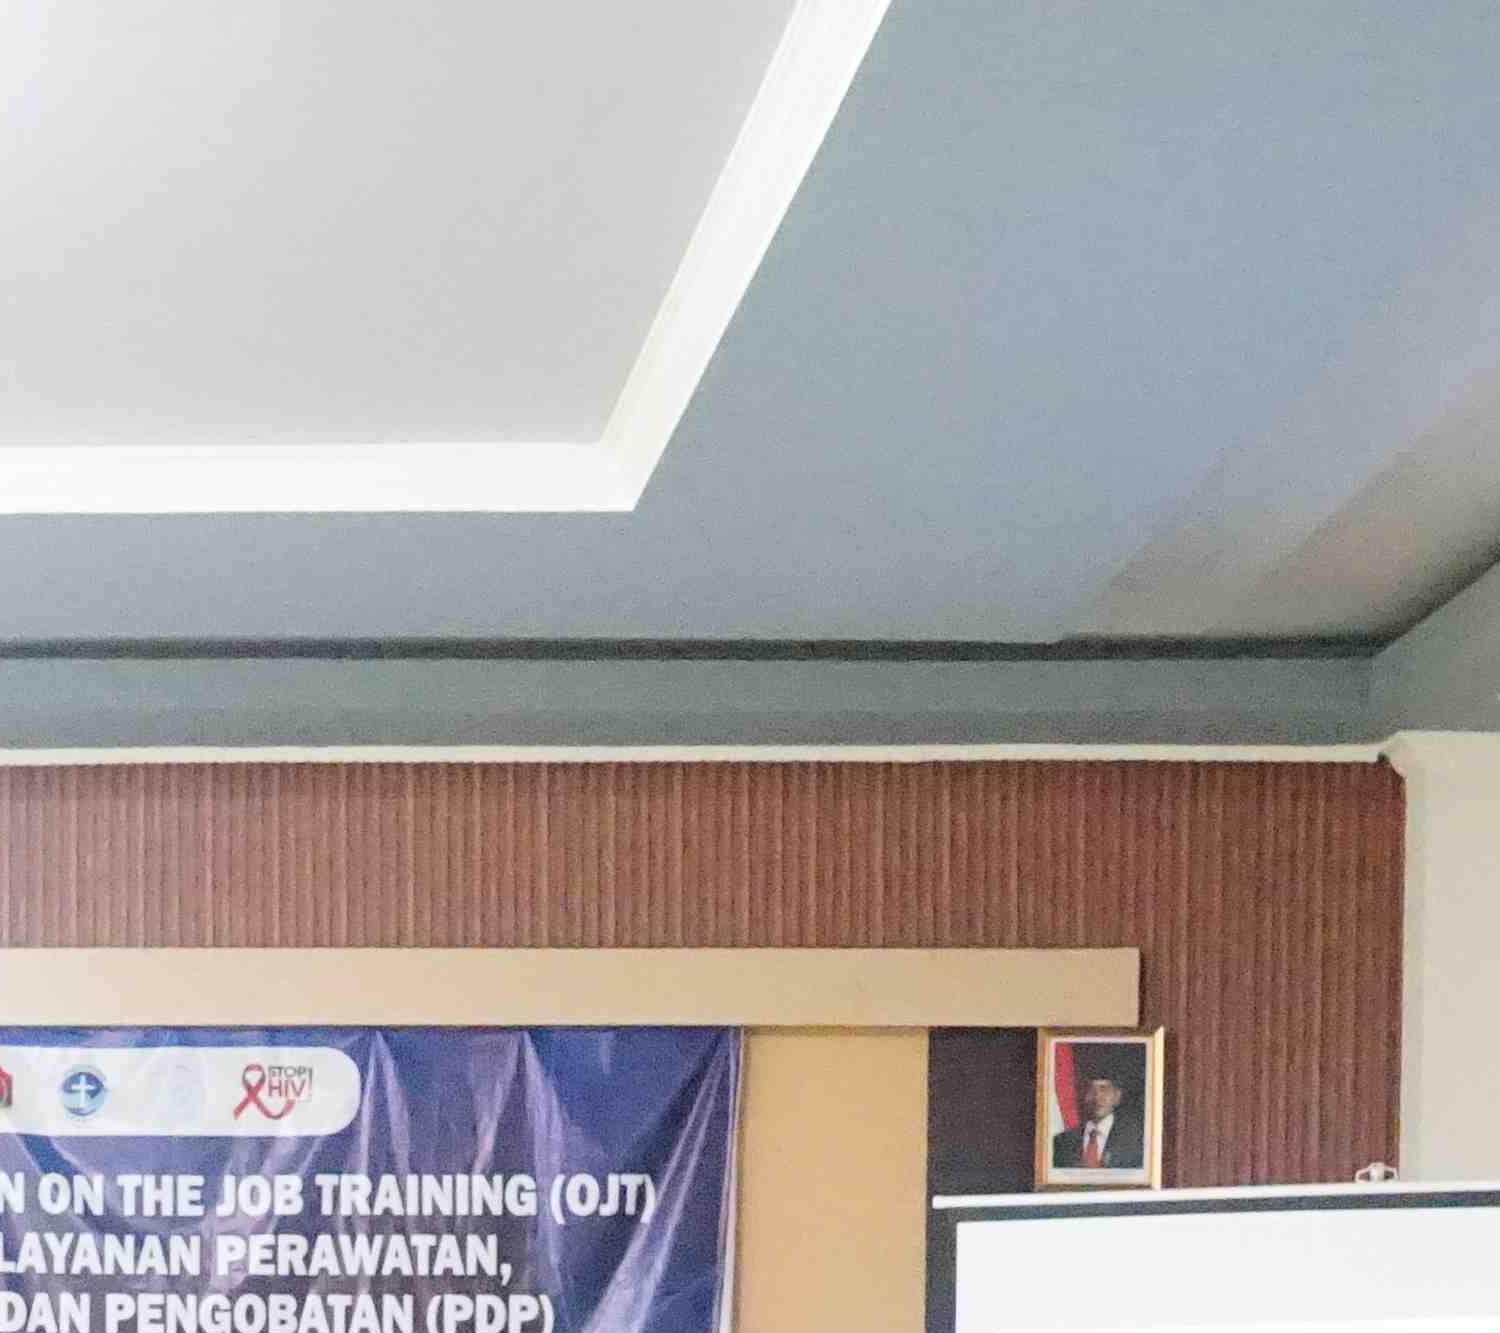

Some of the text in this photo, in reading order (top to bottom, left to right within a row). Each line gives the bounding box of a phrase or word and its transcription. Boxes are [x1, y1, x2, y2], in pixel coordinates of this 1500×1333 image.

[38, 1174, 104, 1215] ON
[117, 1174, 204, 1216] THE
[215, 1174, 303, 1217] JOB
[314, 1174, 537, 1216] TRAINING
[550, 1173, 656, 1224] (OJT)
[216, 1234, 511, 1285] PERAWATAN,
[105, 1294, 413, 1333] PENGOBATAN
